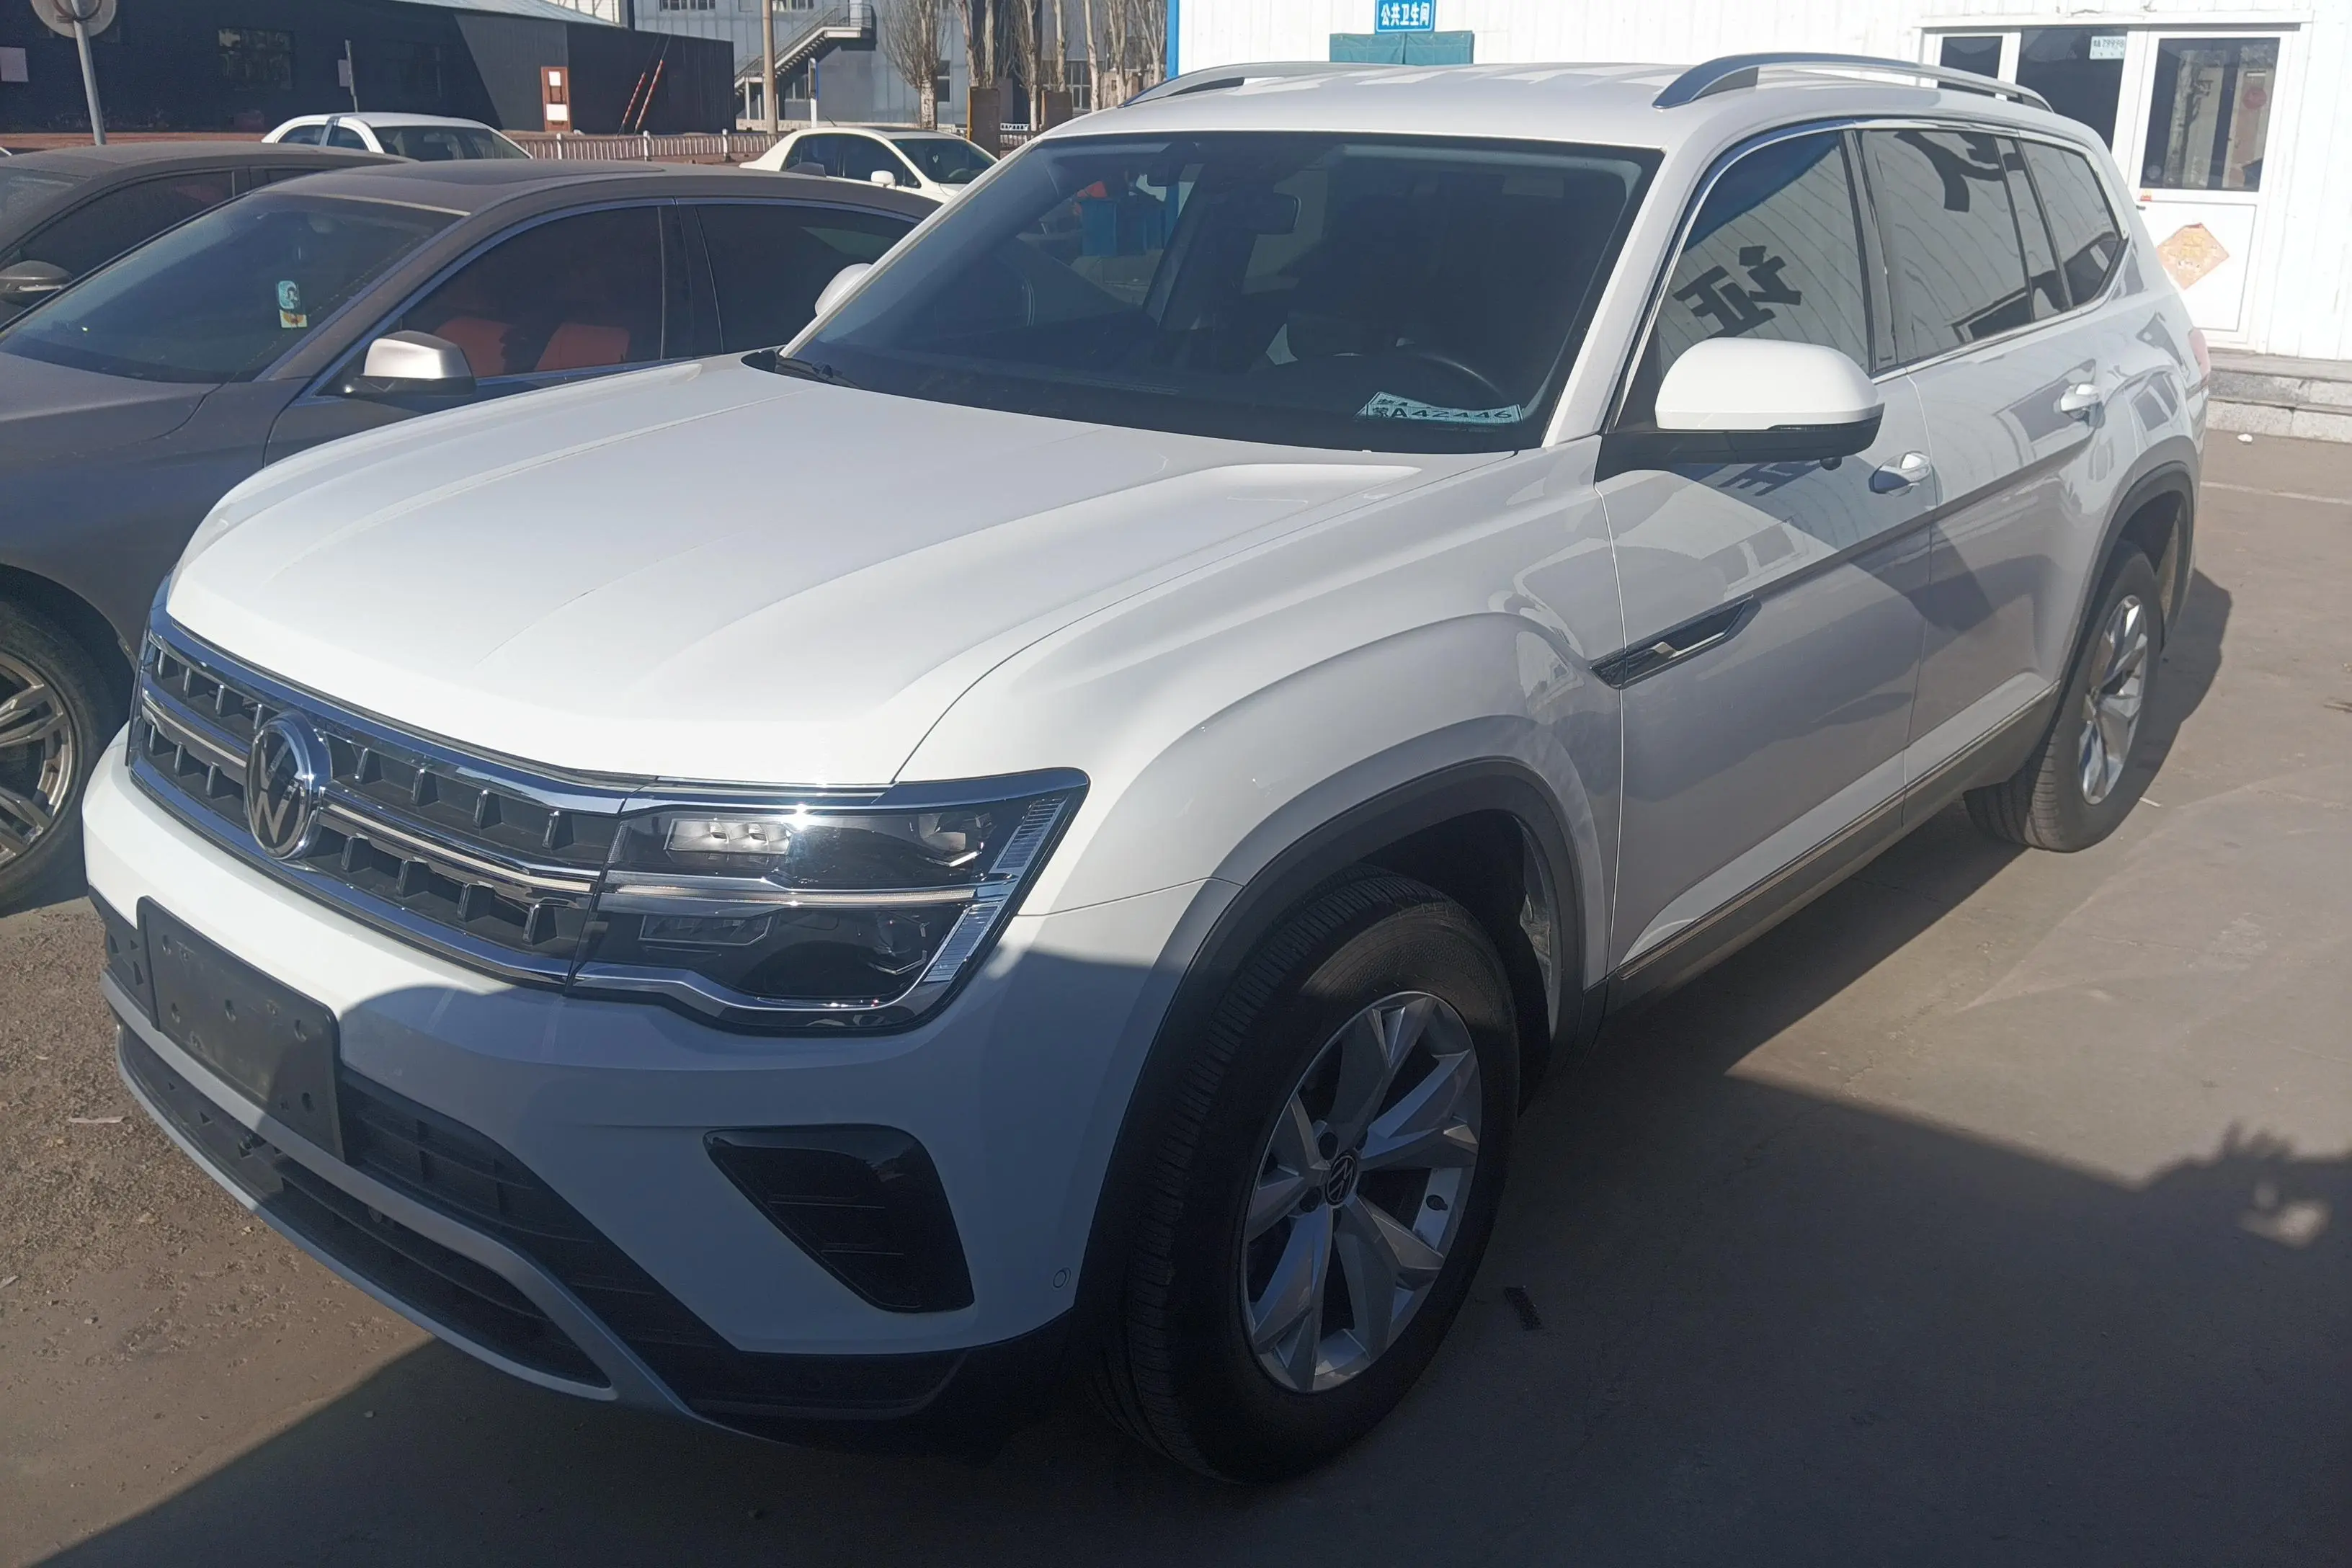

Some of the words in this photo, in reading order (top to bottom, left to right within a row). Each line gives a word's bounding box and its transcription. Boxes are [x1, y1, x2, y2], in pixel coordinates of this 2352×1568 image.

[1381, 2, 1430, 26] 公共卫生间
